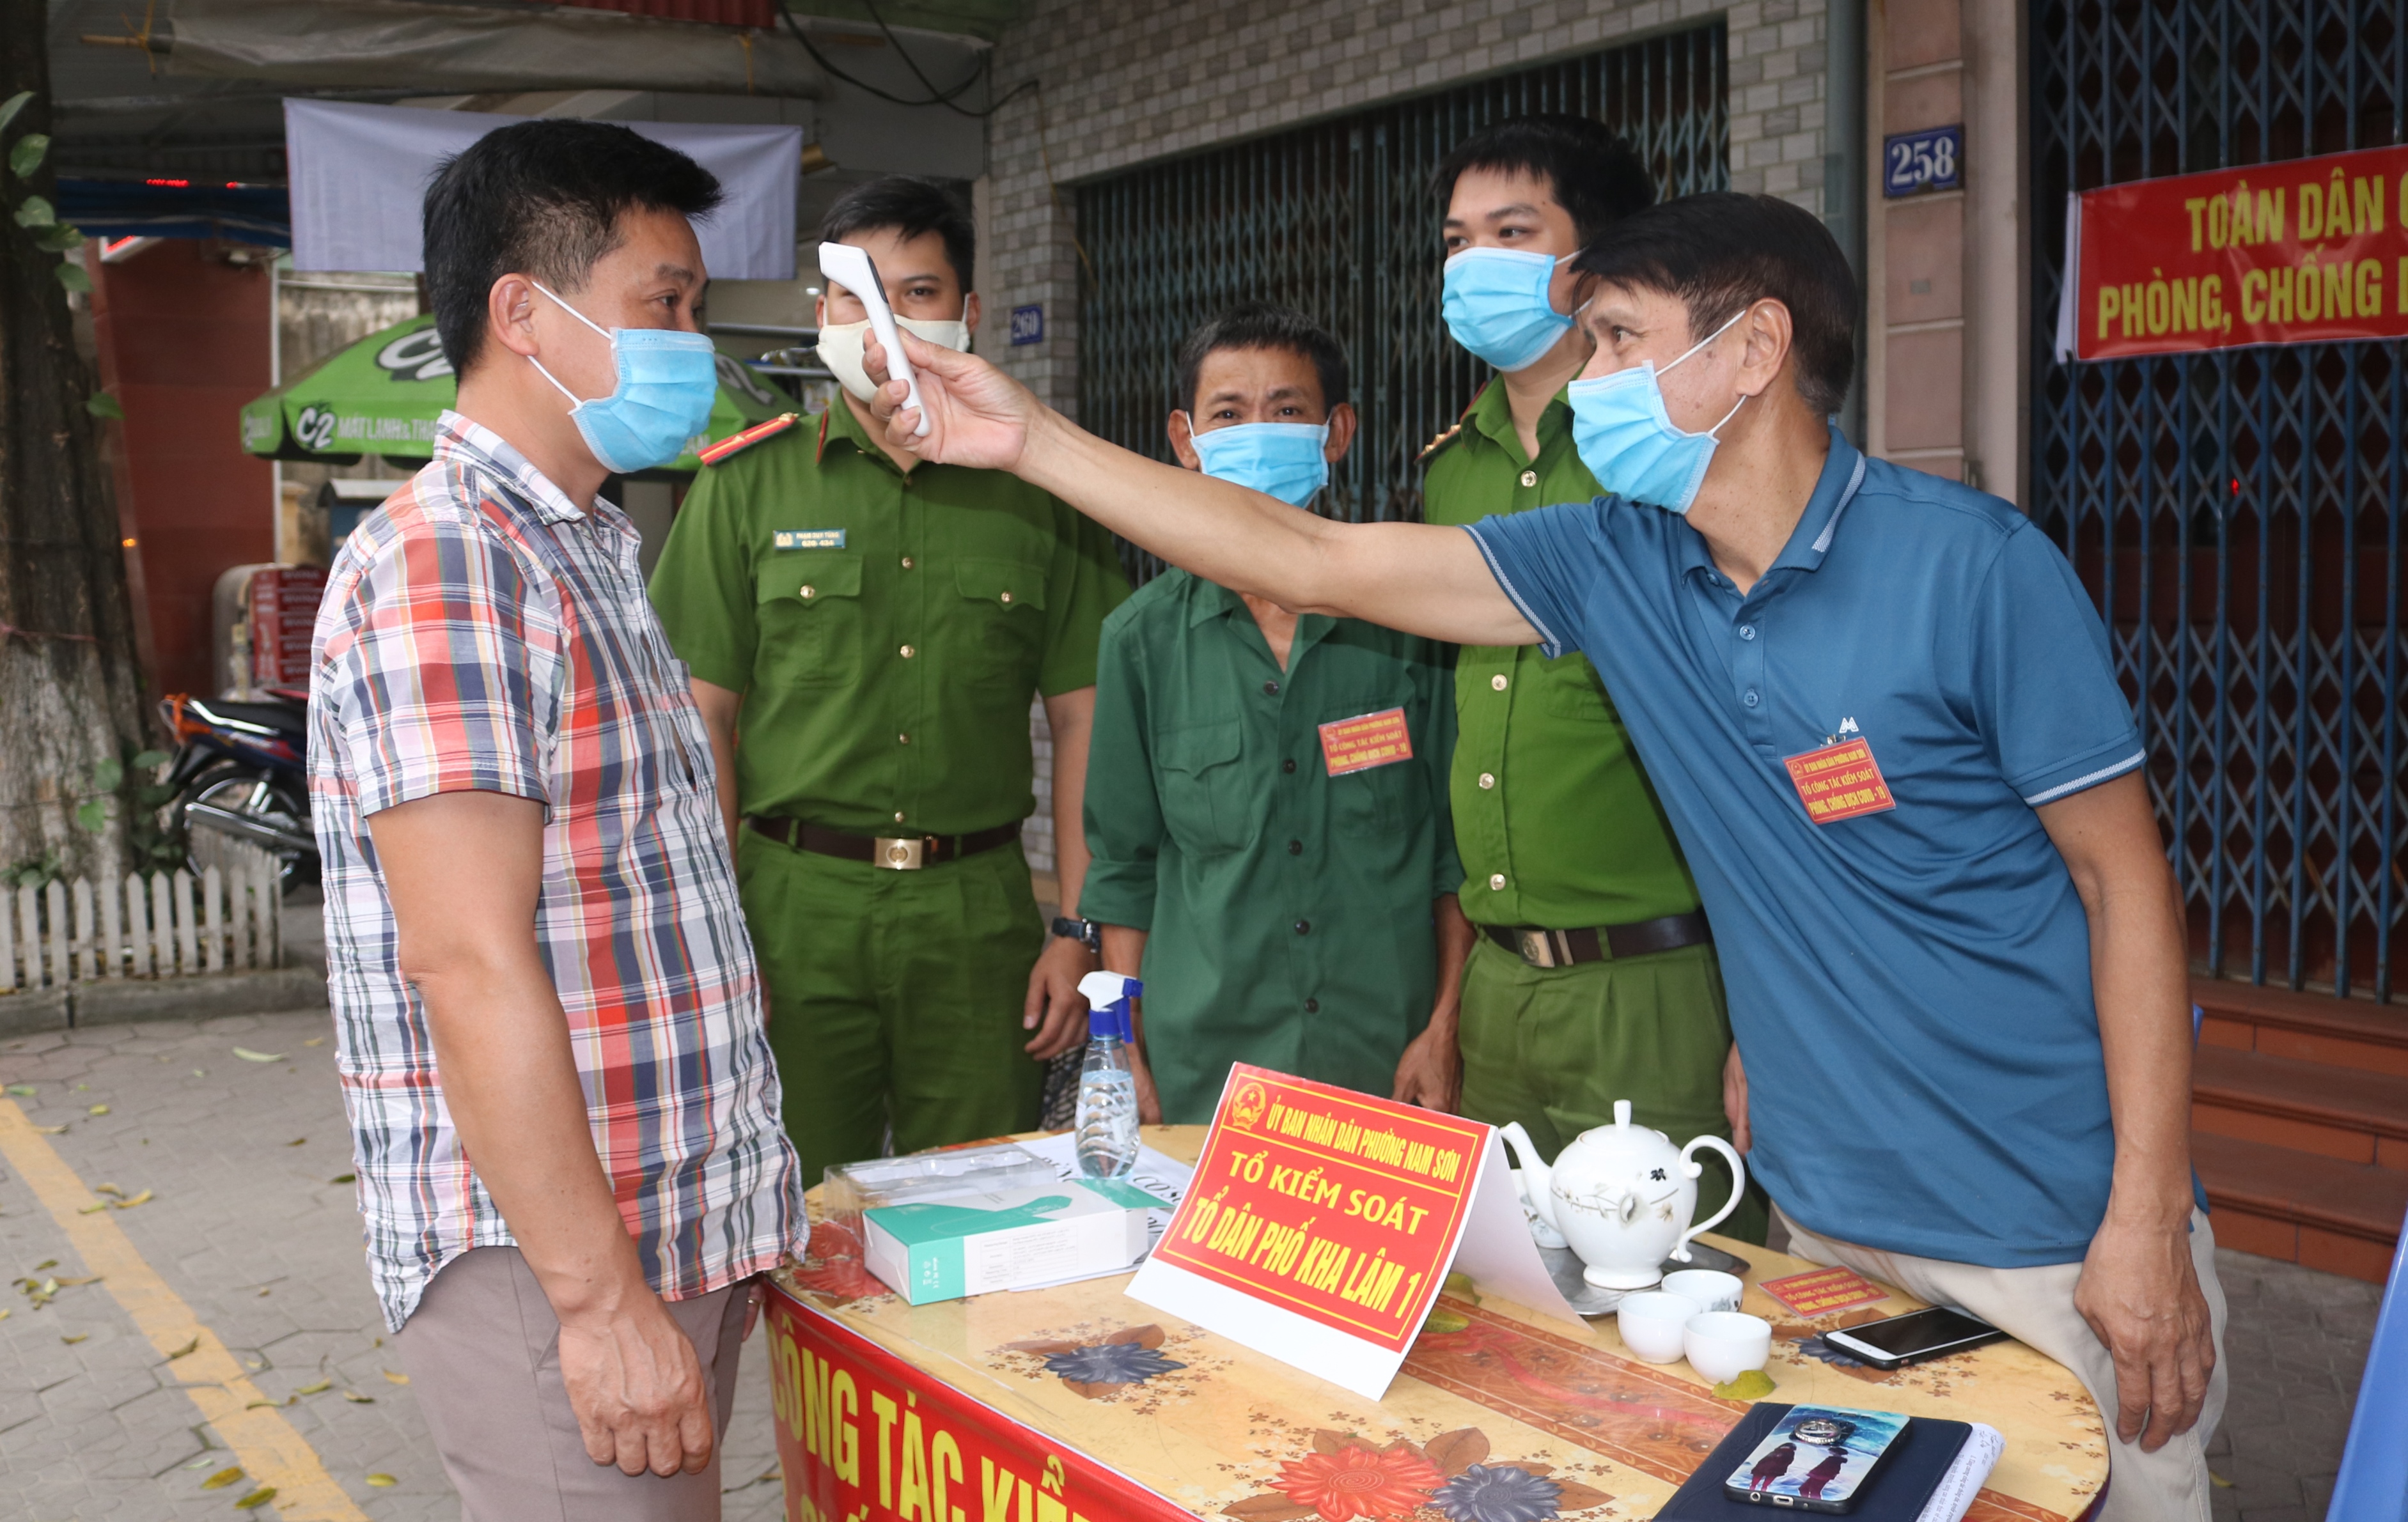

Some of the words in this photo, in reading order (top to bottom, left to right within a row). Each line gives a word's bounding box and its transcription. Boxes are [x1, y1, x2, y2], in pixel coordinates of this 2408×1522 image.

[1890, 136, 1954, 186] 258
[2185, 180, 2285, 252] TOÀN
[2298, 167, 2384, 240] DÂN
[2098, 267, 2232, 339] PHÒNG,
[2242, 243, 2382, 323] CHỐNG
[1811, 780, 1829, 793] CÔNG
[1827, 775, 1842, 788] TÁC
[1856, 767, 1874, 782] SOÁT
[1856, 788, 1875, 804] COVID
[1875, 785, 1886, 799] 19
[1266, 1095, 1286, 1131] ỦY
[1280, 1103, 1308, 1138] BAN
[1303, 1112, 1339, 1147] NHÂN
[1333, 1119, 1361, 1156] DÂN
[1357, 1128, 1407, 1167] PHƯỜNG
[1403, 1140, 1435, 1175] NAM
[1432, 1148, 1461, 1183] SƠN
[1229, 1151, 1269, 1183] TỔ
[1267, 1165, 1342, 1209] KIỂM
[1344, 1189, 1429, 1235] SOÁT
[1181, 1185, 1230, 1244] TỔ
[1206, 1202, 1264, 1261] DÂN
[1249, 1216, 1317, 1277] PHỐ
[1294, 1236, 1352, 1294] KHA
[1340, 1247, 1406, 1312] LÂM
[1395, 1272, 1422, 1319] 1
[765, 1313, 859, 1488] CÔNG
